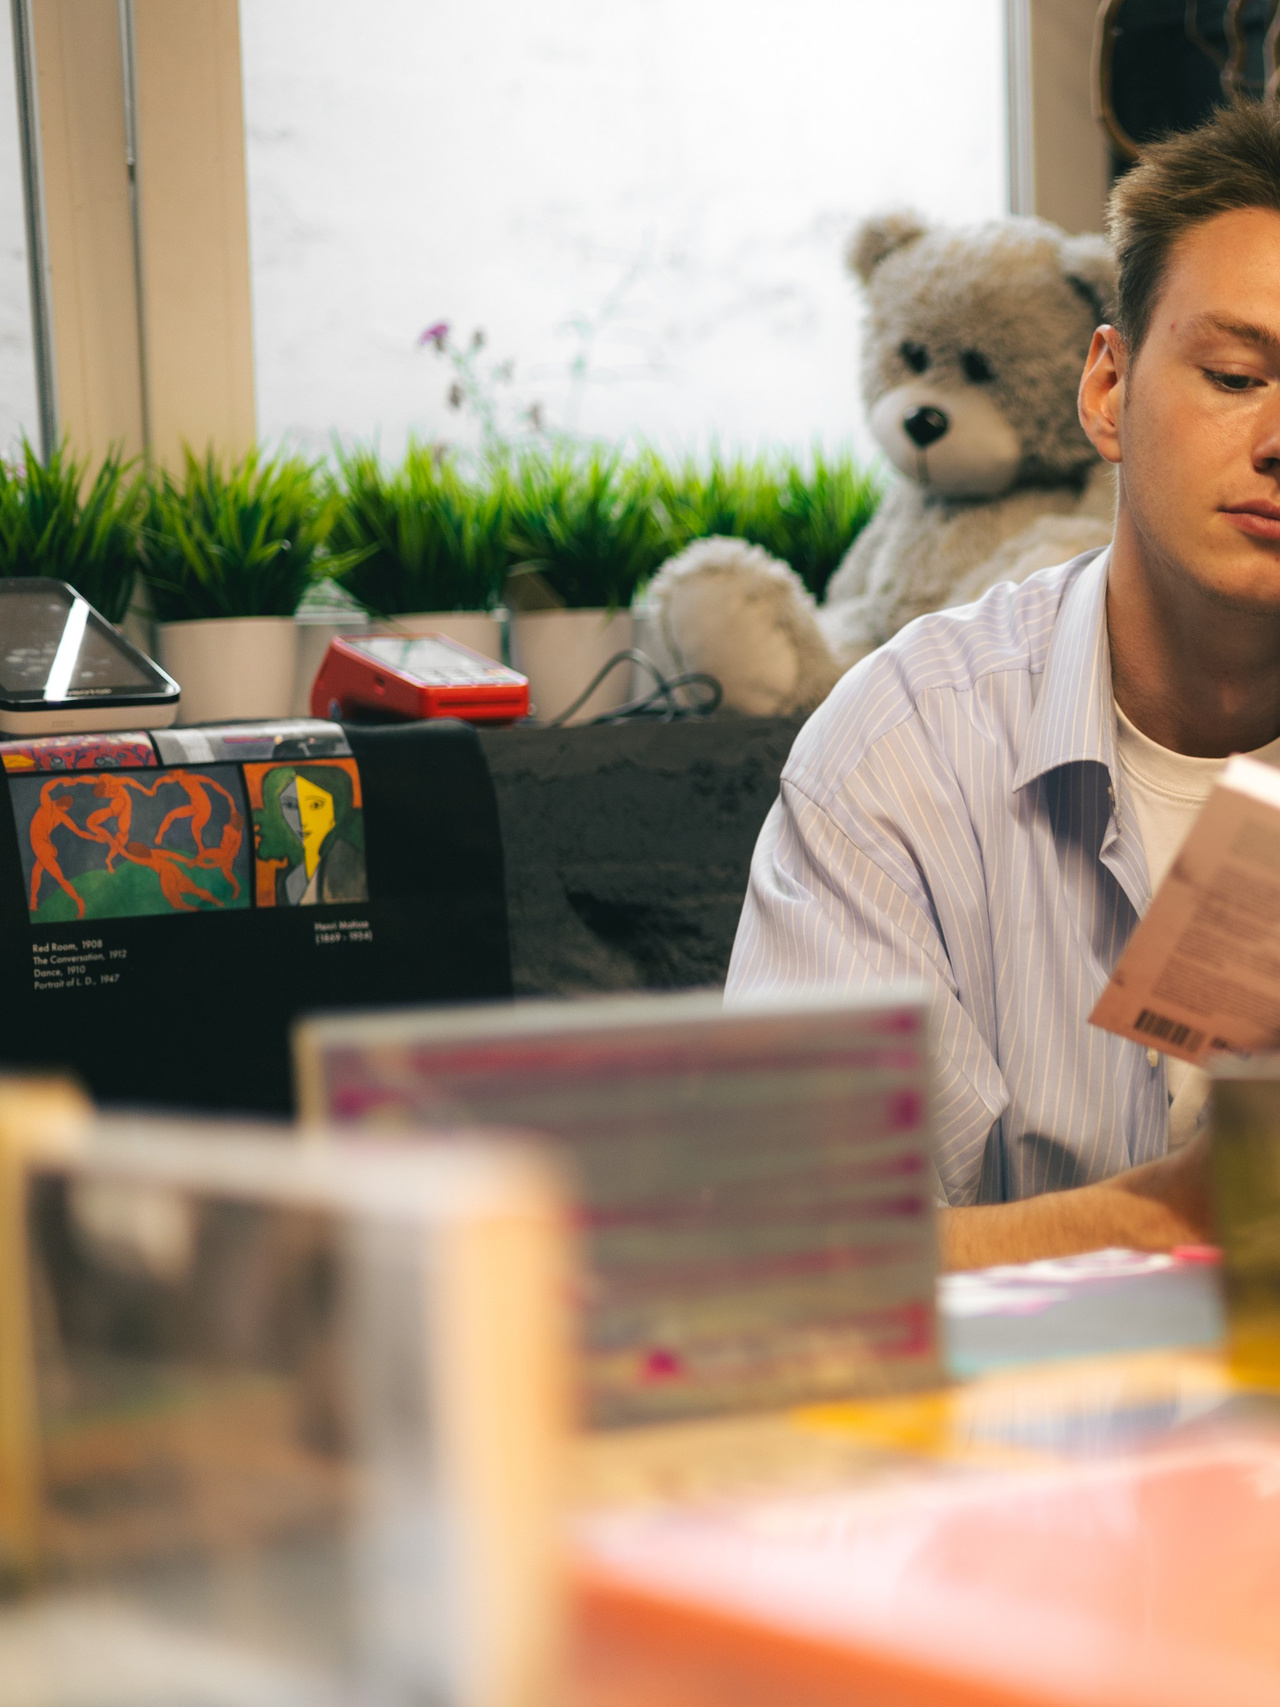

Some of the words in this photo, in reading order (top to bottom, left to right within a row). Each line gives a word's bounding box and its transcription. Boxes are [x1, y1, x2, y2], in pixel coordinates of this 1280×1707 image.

[32, 943, 49, 953] Red
[51, 942, 78, 952] Room,
[82, 939, 103, 949] 1908
[33, 956, 48, 966] The
[50, 952, 105, 964] Conversation,
[109, 949, 128, 959] 1912
[33, 968, 63, 978] Dance,
[67, 965, 86, 975] 1910
[34, 980, 64, 990] Portrait
[66, 976, 75, 987] of
[101, 973, 120, 984] 1947
